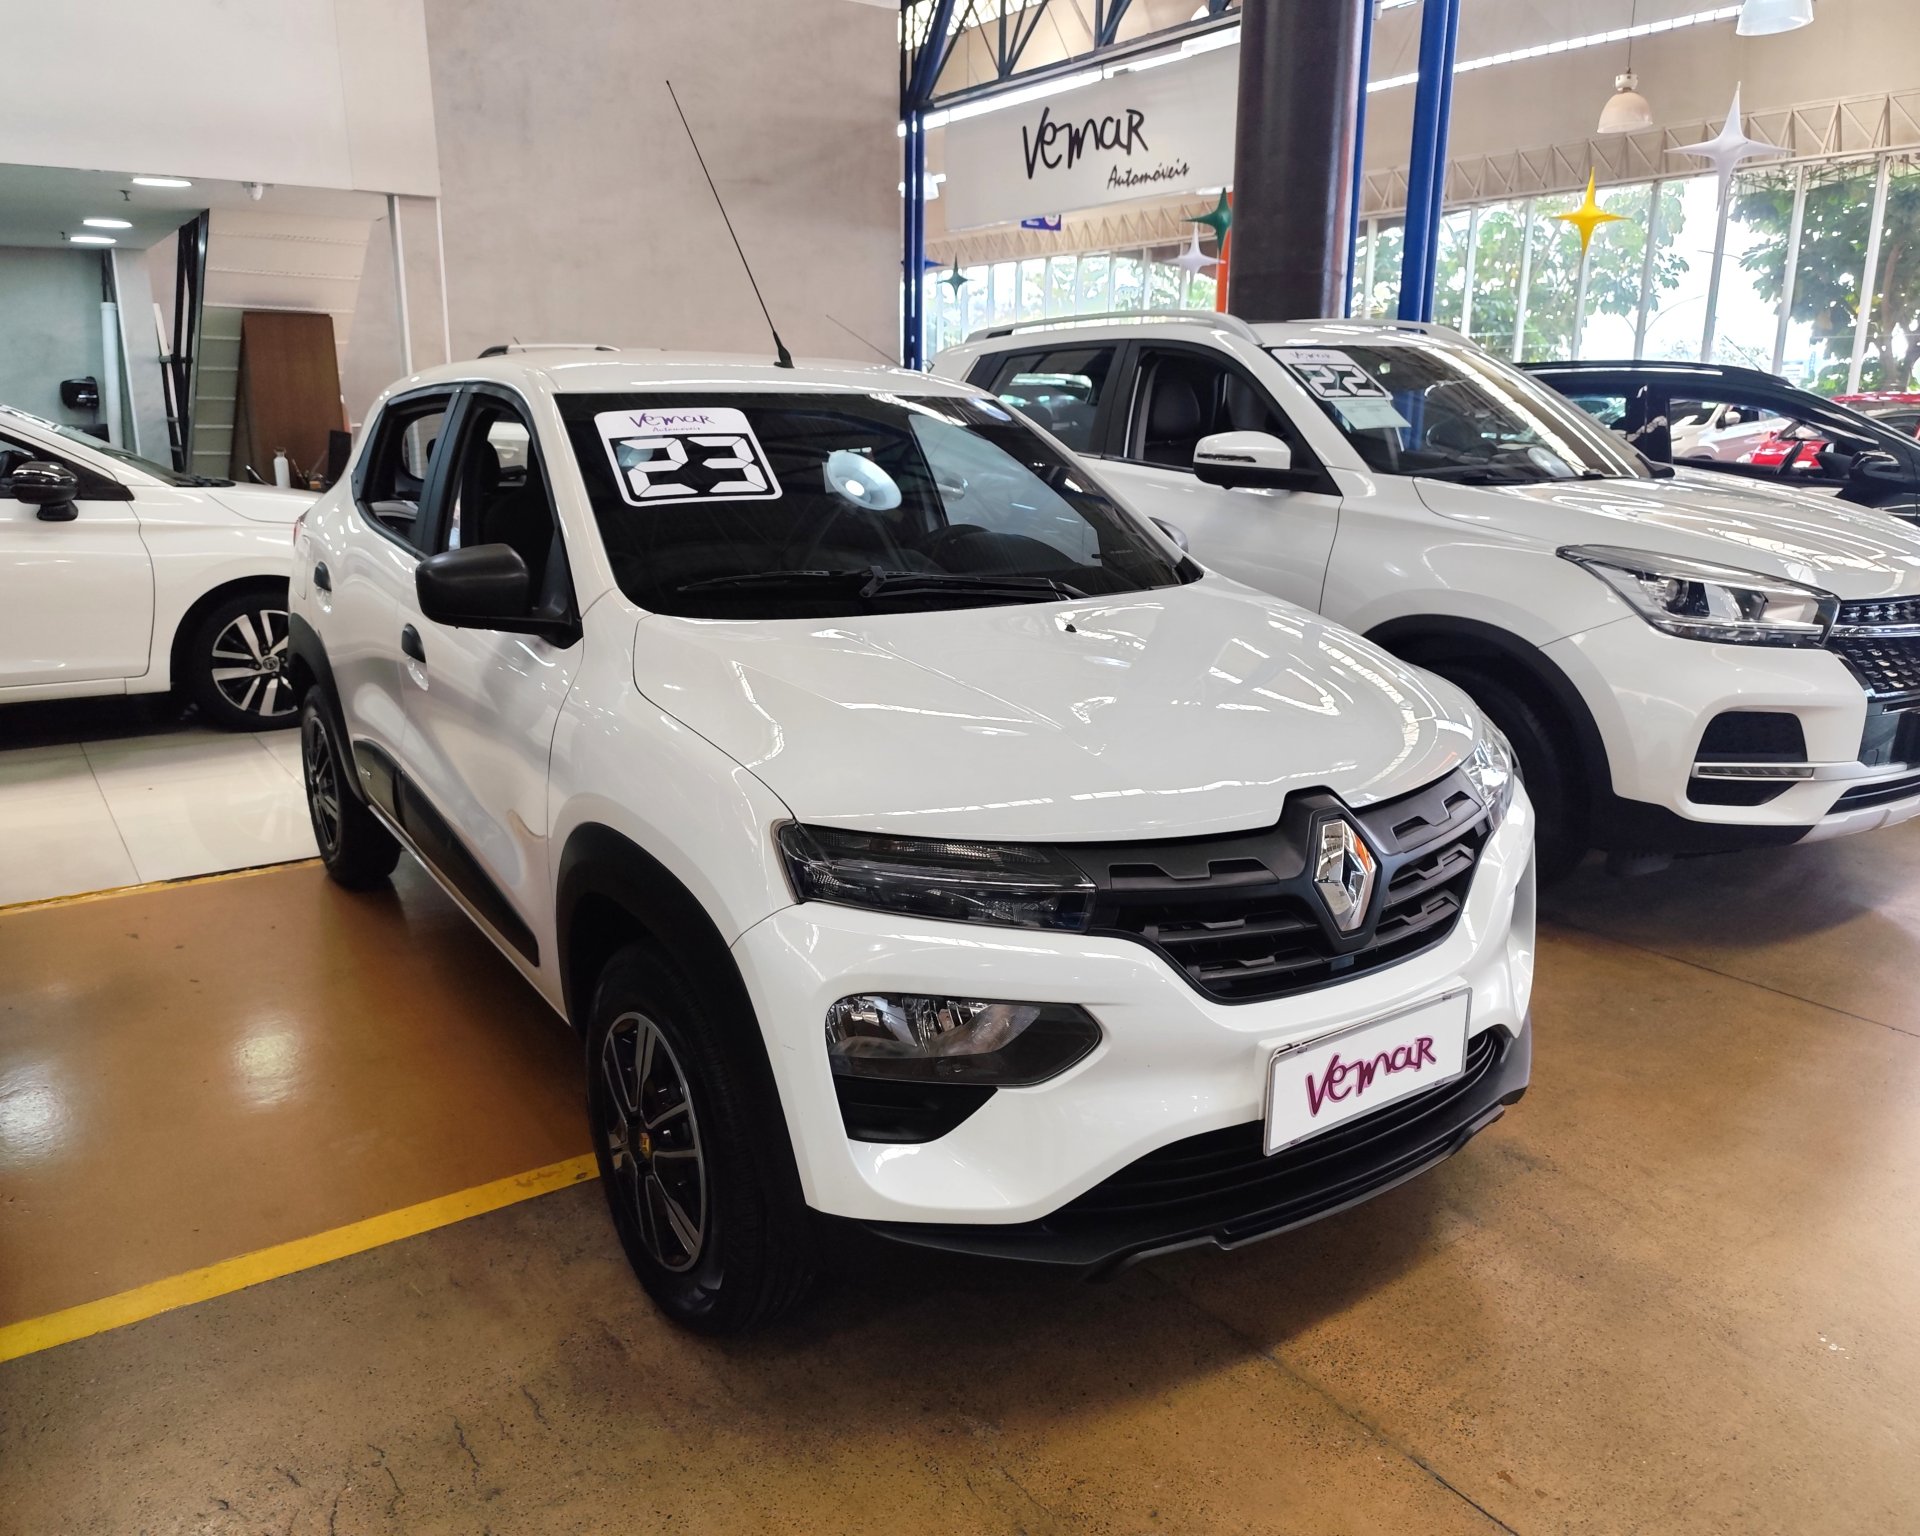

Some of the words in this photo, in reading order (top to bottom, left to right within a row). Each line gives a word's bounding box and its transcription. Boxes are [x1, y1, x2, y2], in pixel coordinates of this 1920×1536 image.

[1106, 158, 1190, 190] Automóveis
[1294, 364, 1385, 397] 22
[619, 436, 768, 498] 23
